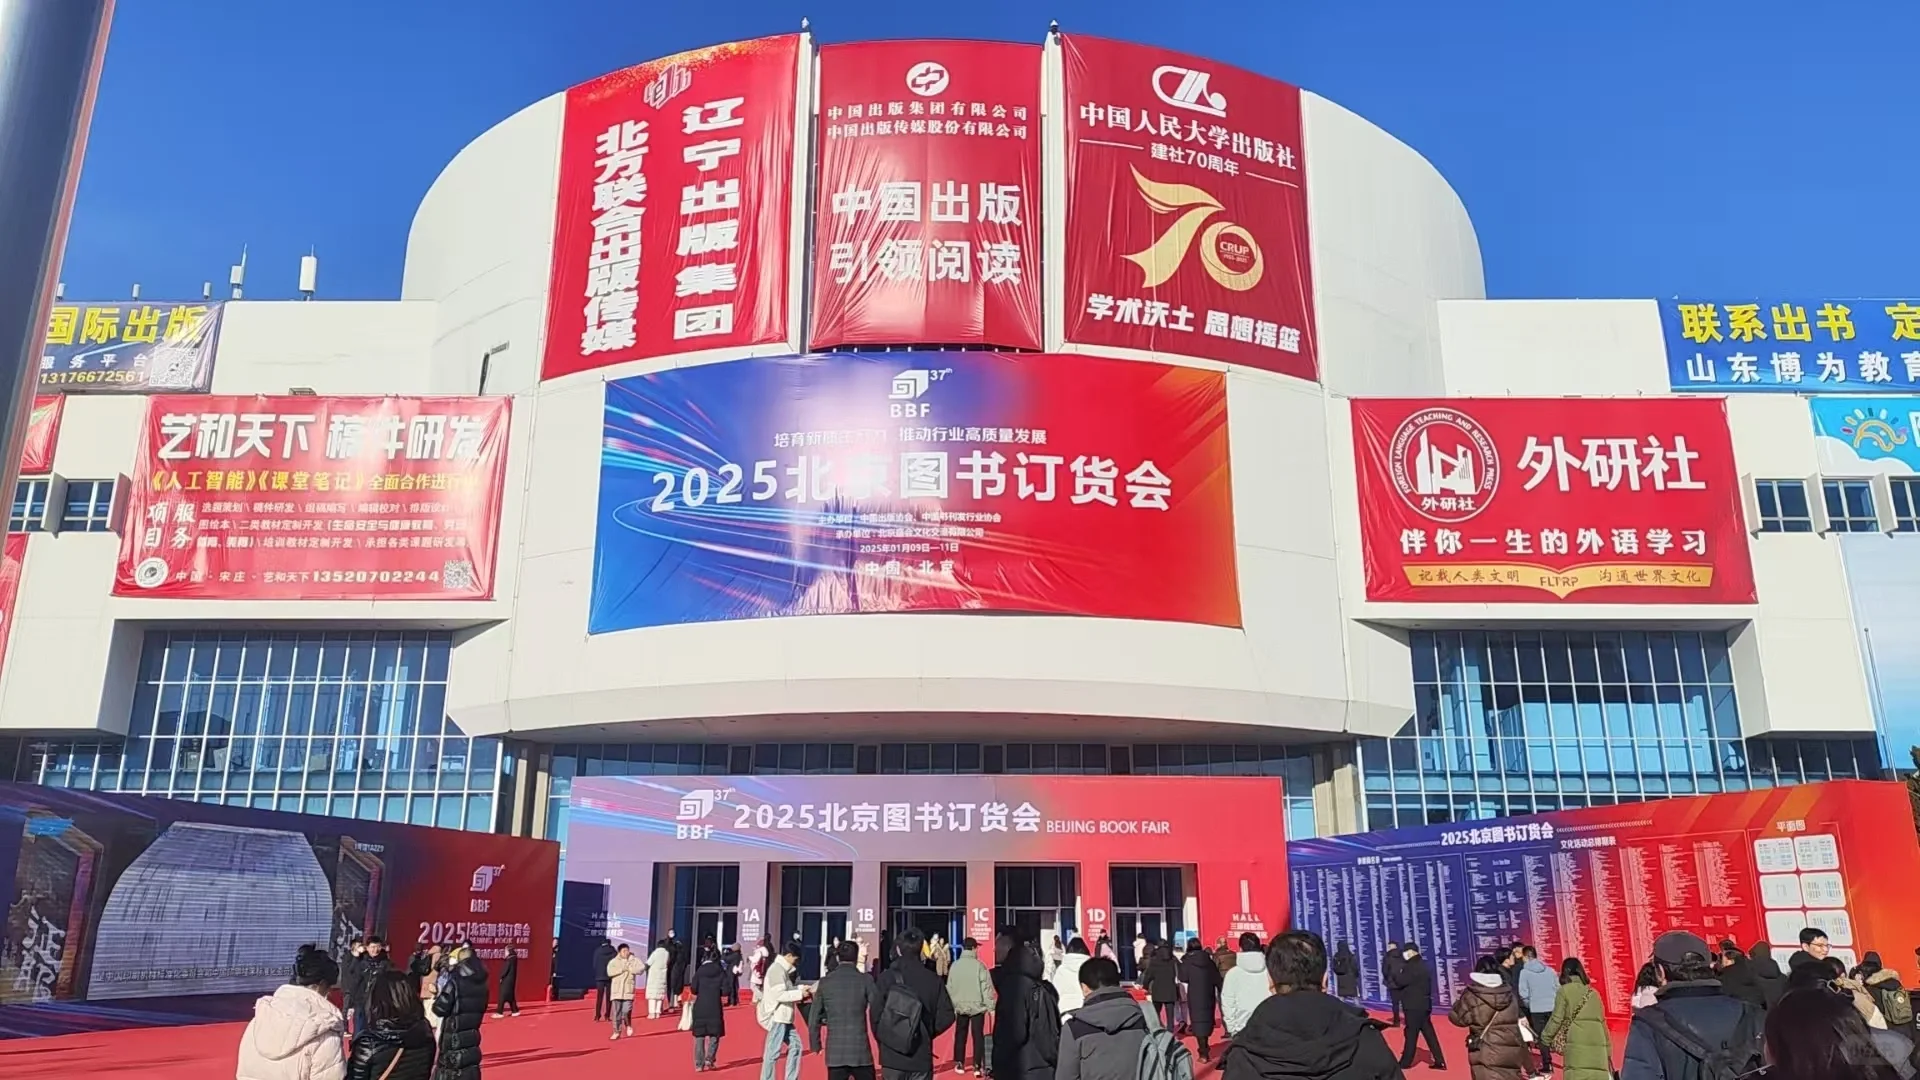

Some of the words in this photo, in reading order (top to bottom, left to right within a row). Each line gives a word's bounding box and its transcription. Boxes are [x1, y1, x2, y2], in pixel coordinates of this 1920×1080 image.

[827, 101, 1027, 121] 中国出版集团有限公司
[827, 119, 1027, 140] 中国出版传媒股份有限公司
[1079, 101, 1297, 170] 中国人民大学出版社
[1151, 142, 1240, 177] 建社70周年
[832, 181, 1022, 226] 中国出版
[673, 96, 745, 340] 辽宁出版集团
[580, 119, 650, 356] 北方联合出版传媒
[1220, 241, 1250, 255] CRUP
[830, 239, 1022, 285] 引领阅读
[46, 305, 208, 345] 国际出版
[1087, 293, 1195, 332] 学术沃土
[1204, 309, 1300, 353] 思想摇篮
[1678, 303, 1856, 343] 联系出书
[41, 354, 148, 369] 服务平台
[890, 403, 931, 418] BBF
[1415, 412, 1453, 426] TEACHING
[1455, 417, 1472, 431] AND
[157, 413, 317, 461] 艺和天下
[326, 413, 484, 461] 稿件研发
[900, 426, 1047, 445] 推动行业高质量发展
[1394, 423, 1416, 460] LANGUAGE
[1471, 430, 1494, 465] RESEARCH
[1517, 435, 1706, 492] 外研社
[651, 449, 1173, 512] 2025北京图书订货会
[1394, 461, 1412, 495] FOREIGN
[1483, 466, 1495, 490] PRESS
[1421, 496, 1477, 511] 外研社
[1401, 528, 1706, 555] 伴你一生的外语学习
[313, 570, 439, 583] 13520702244
[1418, 569, 1520, 582] 记载人类文明
[1540, 576, 1579, 587] FLTRP
[1599, 569, 1701, 582] 沟通世界文化
[734, 801, 1041, 833] 2025北京图书订货会
[1046, 820, 1096, 834] BEIJING
[1099, 820, 1138, 834] BOOK
[1141, 820, 1171, 834] FAIR
[676, 824, 714, 840] BBF
[1441, 822, 1554, 846] 2025北京图书订货会
[470, 899, 491, 912] BBF
[742, 909, 760, 922] 1A
[857, 908, 874, 921] 1B
[972, 907, 989, 921] 1C
[1087, 908, 1106, 922] 1D
[1232, 913, 1261, 921] HALL
[418, 922, 466, 944] 2025
[470, 923, 531, 937] 北京图书订货会
